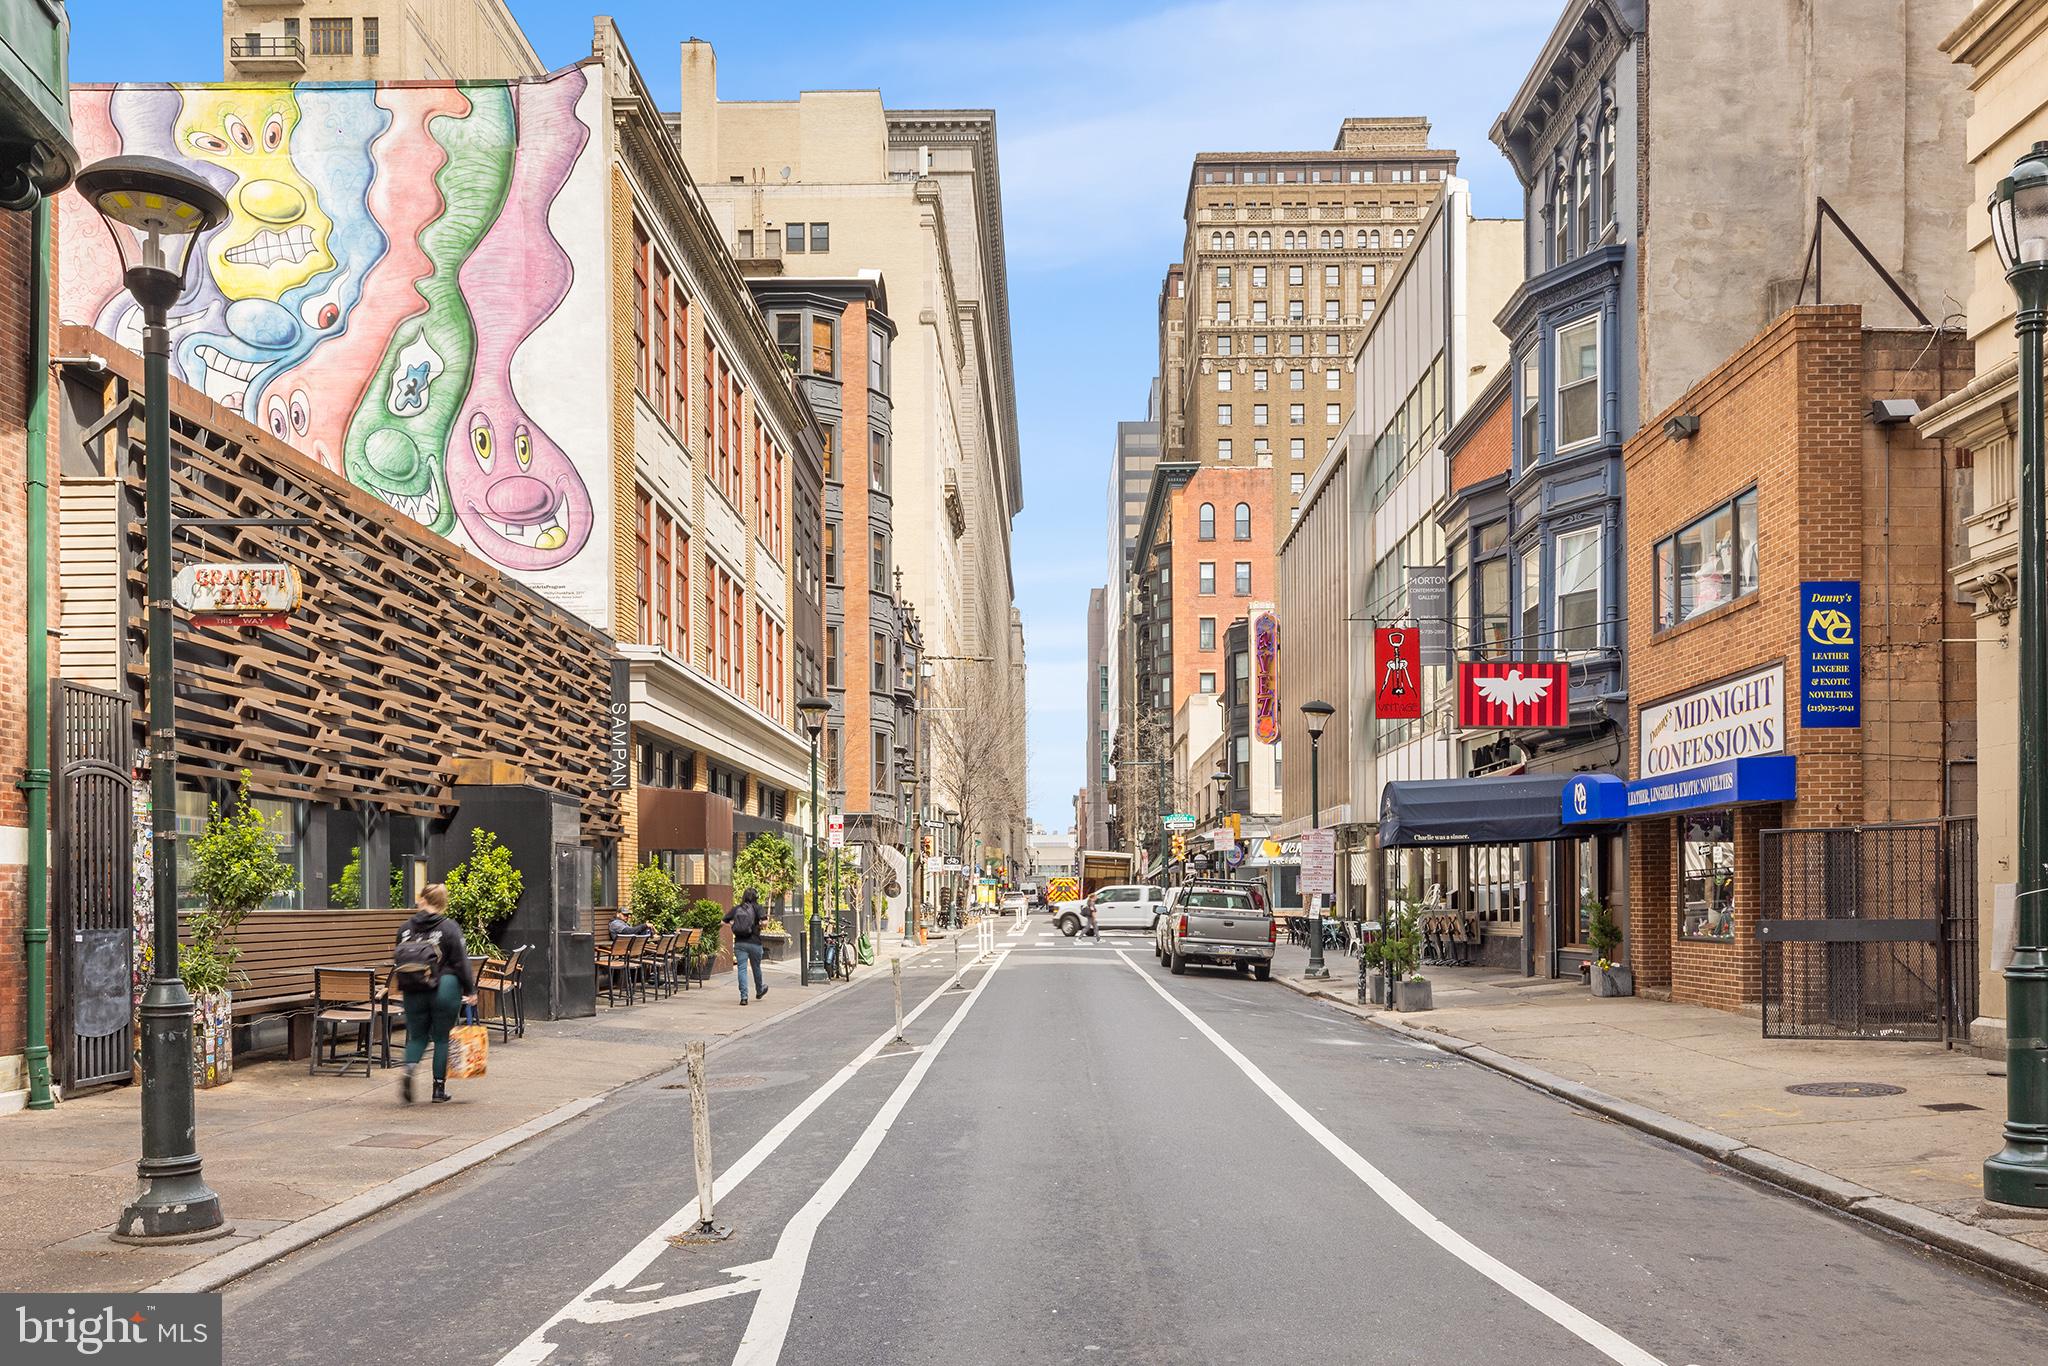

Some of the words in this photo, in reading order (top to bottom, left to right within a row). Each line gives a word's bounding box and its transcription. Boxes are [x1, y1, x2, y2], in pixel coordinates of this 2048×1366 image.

[1409, 576, 1446, 585] MORTON
[219, 586, 266, 606] BAR
[1811, 593, 1852, 604] Danny's
[1812, 652, 1849, 660] LEATHER
[1812, 665, 1850, 673] LINGERIE
[1811, 678, 1819, 686] &
[1820, 678, 1851, 686] EXOTIC
[1808, 691, 1854, 699] NOVELTIES
[1377, 703, 1418, 712] VINTAGE
[1649, 707, 1673, 744] Danny's
[1674, 675, 1775, 732] MIDNIGHT
[1807, 704, 1855, 713] (215)925-5041
[611, 702, 627, 787] SAMPAN
[1647, 717, 1774, 774] CONFESSIONS
[1650, 784, 1674, 801] LINGERIE
[1674, 783, 1679, 799] &
[1679, 780, 1700, 797] EXOTIC
[1700, 772, 1733, 794] NOVELTIES
